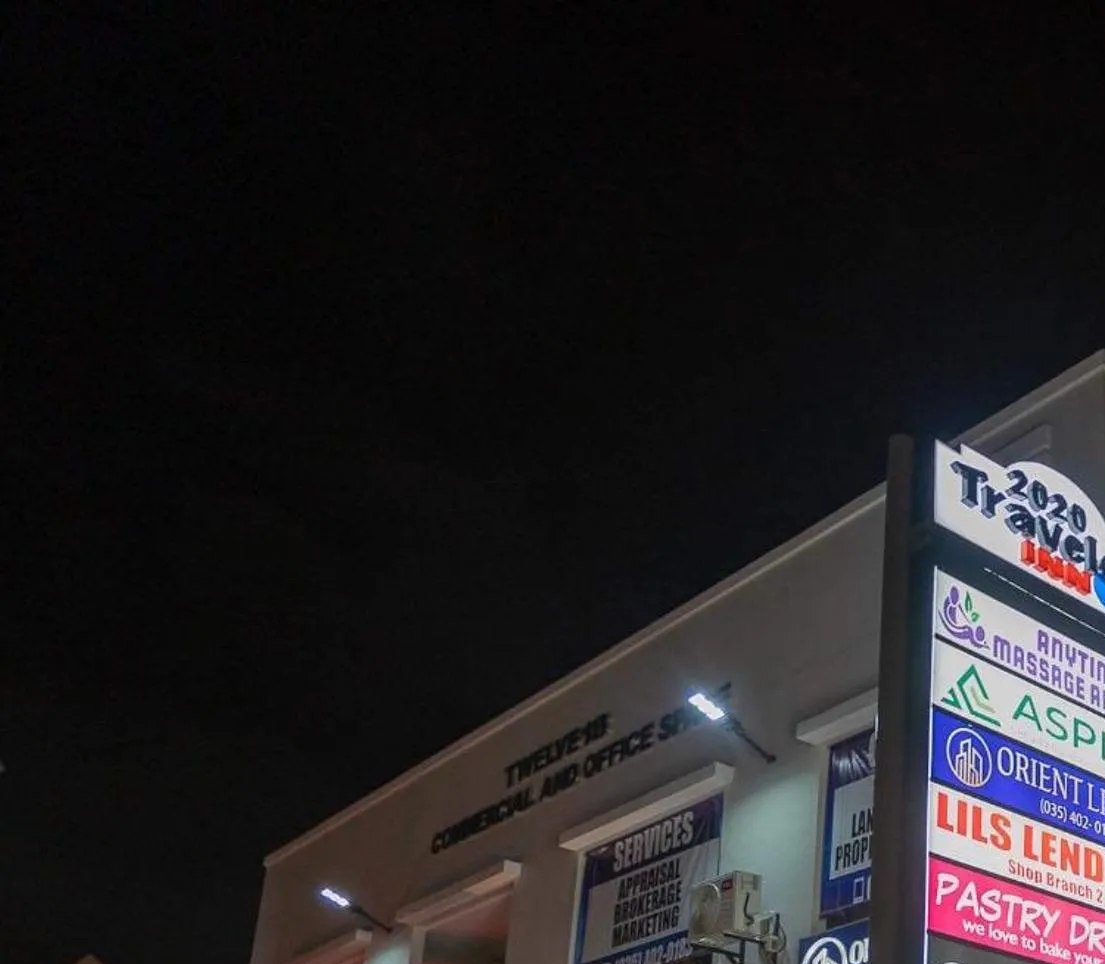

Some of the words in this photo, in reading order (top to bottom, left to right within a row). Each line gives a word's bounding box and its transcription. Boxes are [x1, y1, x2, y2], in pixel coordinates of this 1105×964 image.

[1005, 469, 1087, 534] 2020
[992, 635, 1086, 701] MASSAGE
[997, 746, 1085, 806] ORIENT
[852, 807, 873, 838] LAN
[936, 792, 1012, 852] LILS
[1039, 798, 1067, 824] (035)
[613, 811, 694, 873] SERVICES
[835, 835, 872, 871] PROP
[617, 857, 681, 899] APPRAISAL
[1008, 858, 1043, 886] Shop
[1046, 870, 1095, 901] Branch
[1096, 888, 1103, 904] 2
[613, 881, 682, 925] BROKERAGE
[935, 872, 1062, 938] PASTRY
[611, 905, 680, 948] MARKETING
[962, 919, 985, 936] we
[988, 923, 1019, 944] love
[1021, 933, 1036, 950] to
[1040, 939, 1071, 961] bake
